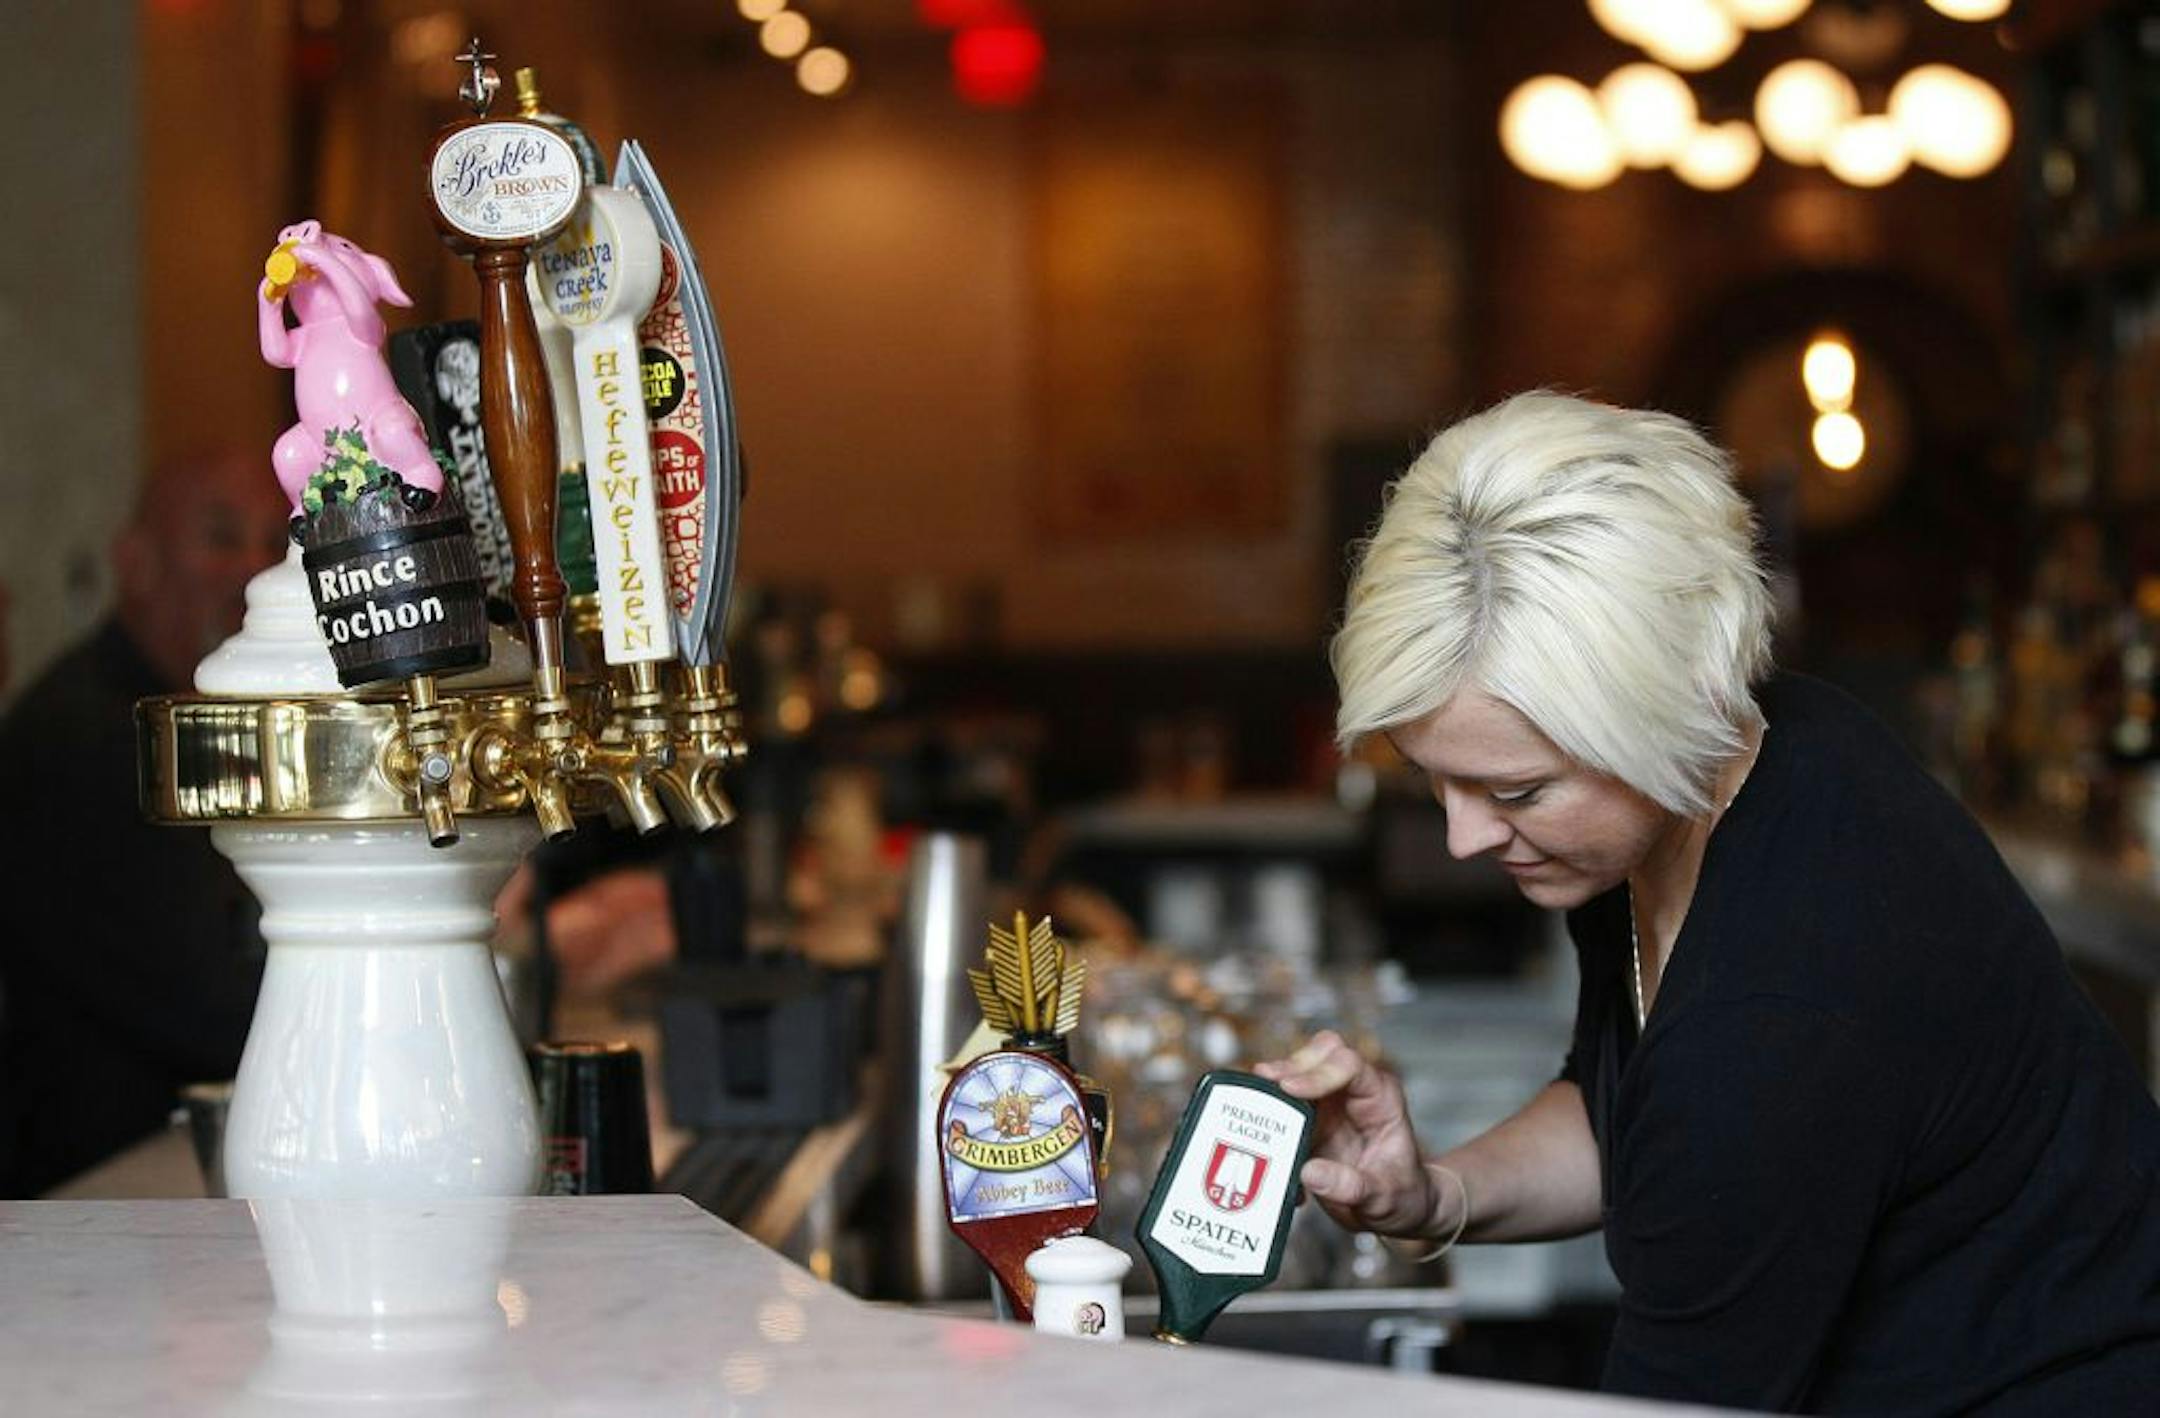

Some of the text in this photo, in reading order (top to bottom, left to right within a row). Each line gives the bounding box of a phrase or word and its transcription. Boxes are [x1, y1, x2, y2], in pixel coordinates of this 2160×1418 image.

[441, 138, 547, 197] Brekle's
[494, 175, 569, 196] BROWN
[641, 360, 676, 382] COA
[656, 470, 700, 495] AITH
[317, 555, 417, 603] Rince
[317, 596, 445, 648] Cochon
[1222, 1104, 1288, 1135] PREMIUM
[1228, 1120, 1272, 1144] LAGER
[951, 1120, 1080, 1166] GRIMBERGEN
[1170, 1209, 1260, 1252] SPATEN
